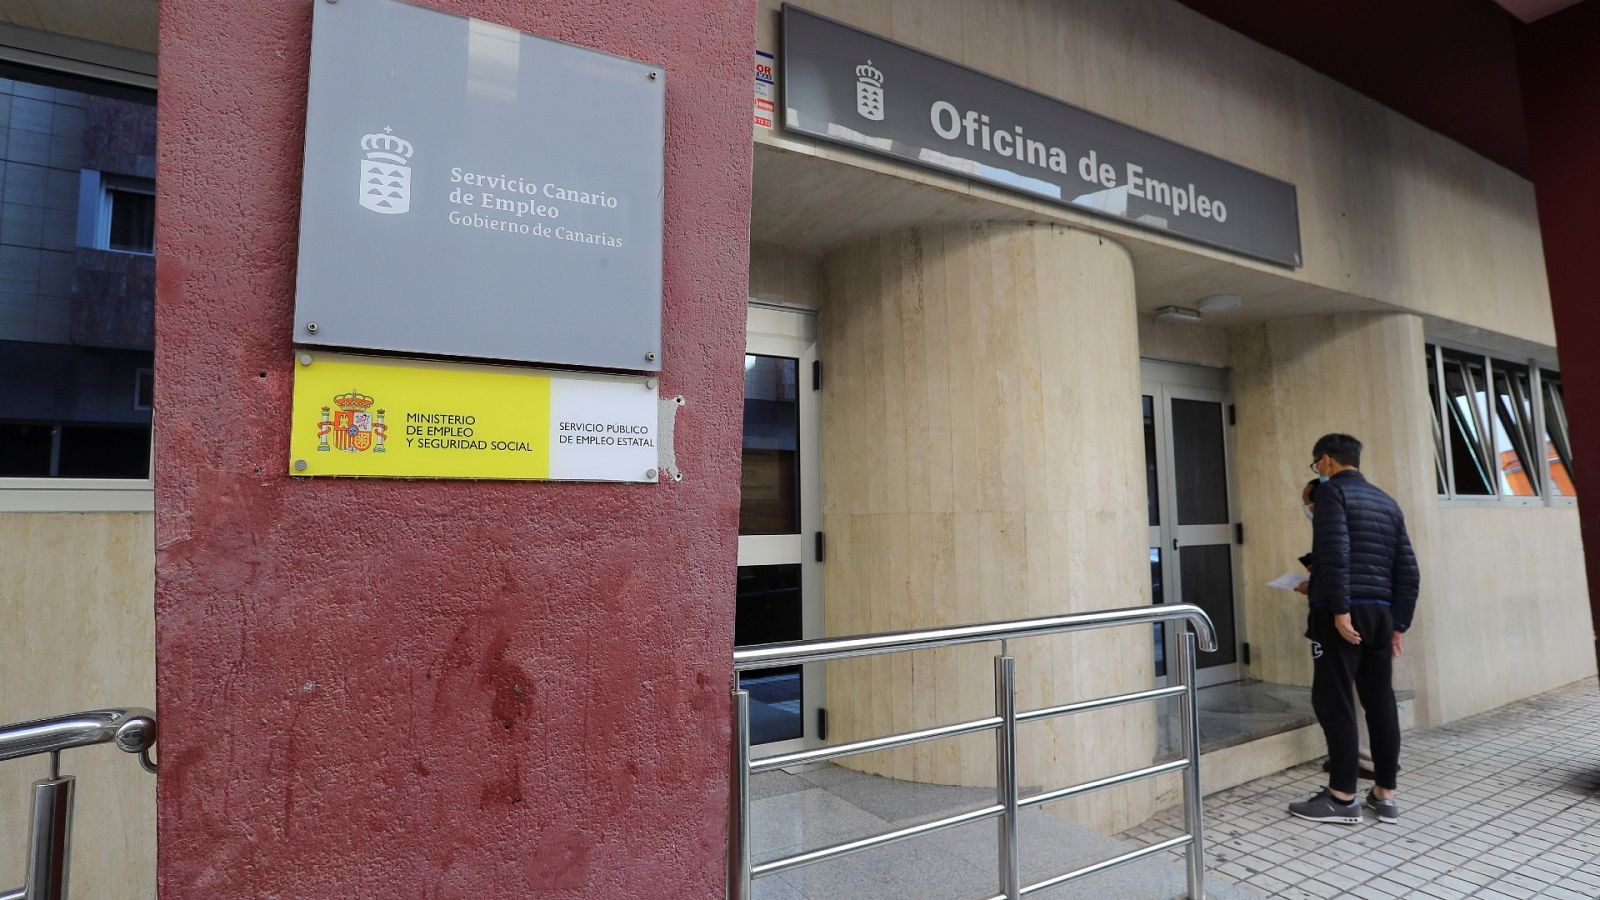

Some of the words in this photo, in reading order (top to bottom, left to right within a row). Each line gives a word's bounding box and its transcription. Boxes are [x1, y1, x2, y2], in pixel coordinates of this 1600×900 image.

[930, 100, 1067, 174] Oficina
[1078, 150, 1117, 188] de
[1126, 162, 1227, 223] Empleo
[450, 167, 537, 195] Servicio
[542, 183, 618, 208] Canario
[449, 187, 474, 206] de
[481, 192, 559, 218] Empleo
[449, 211, 529, 234] Gobierno
[532, 223, 552, 238] de
[555, 226, 623, 248] Canarias
[406, 412, 476, 425] MINISTERIO
[406, 425, 423, 436] DE
[427, 426, 474, 438] EMPLEO
[559, 421, 604, 433] SERVICIO
[606, 422, 648, 434] PÚBLICO
[406, 438, 414, 448] Y
[417, 438, 488, 450] SEGURIDAD
[491, 440, 533, 452] SOCIAL
[559, 434, 573, 444] DE
[576, 435, 615, 446] EMPLEO
[617, 437, 655, 447] ESTATAL
